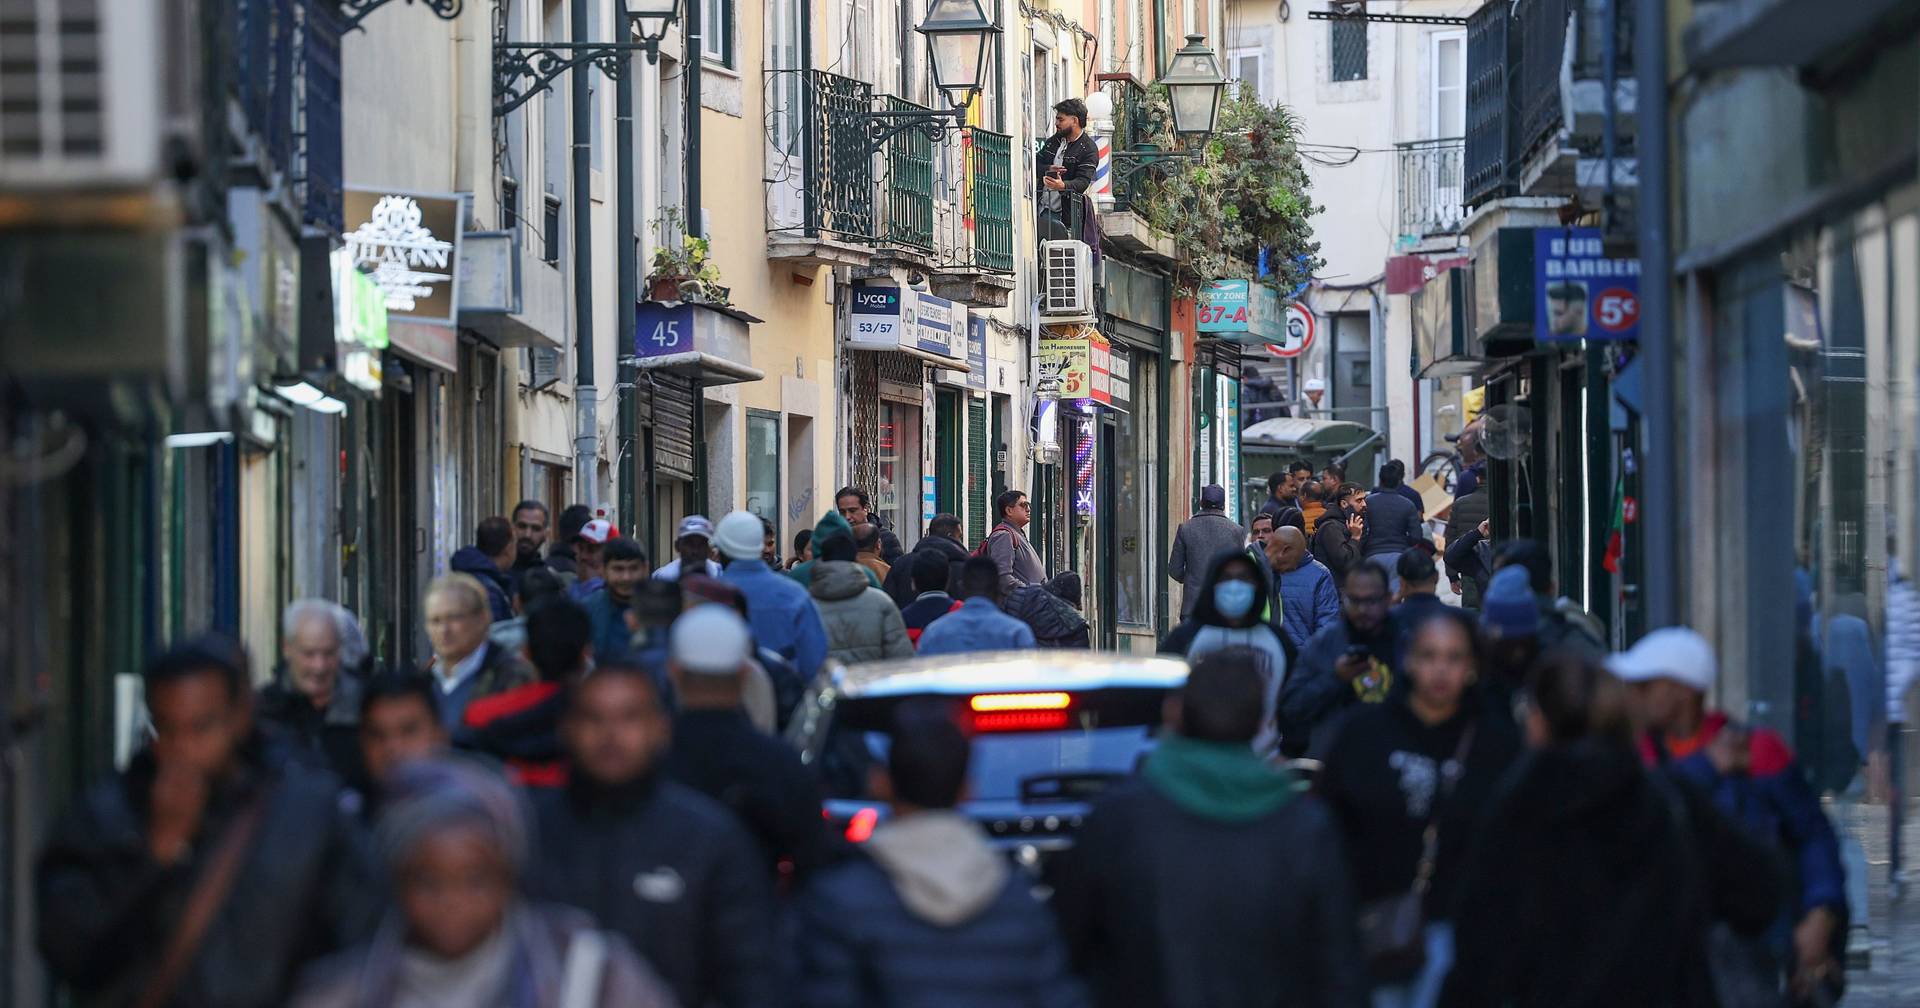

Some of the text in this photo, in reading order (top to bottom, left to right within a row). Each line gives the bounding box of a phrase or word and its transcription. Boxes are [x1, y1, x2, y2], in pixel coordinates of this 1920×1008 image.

[1545, 259, 1641, 278] BARBER
[857, 292, 886, 305] Lyca
[1223, 292, 1247, 300] ZONE
[1199, 306, 1248, 324] 67-A
[652, 320, 679, 347] 45
[859, 322, 892, 334] 53/57
